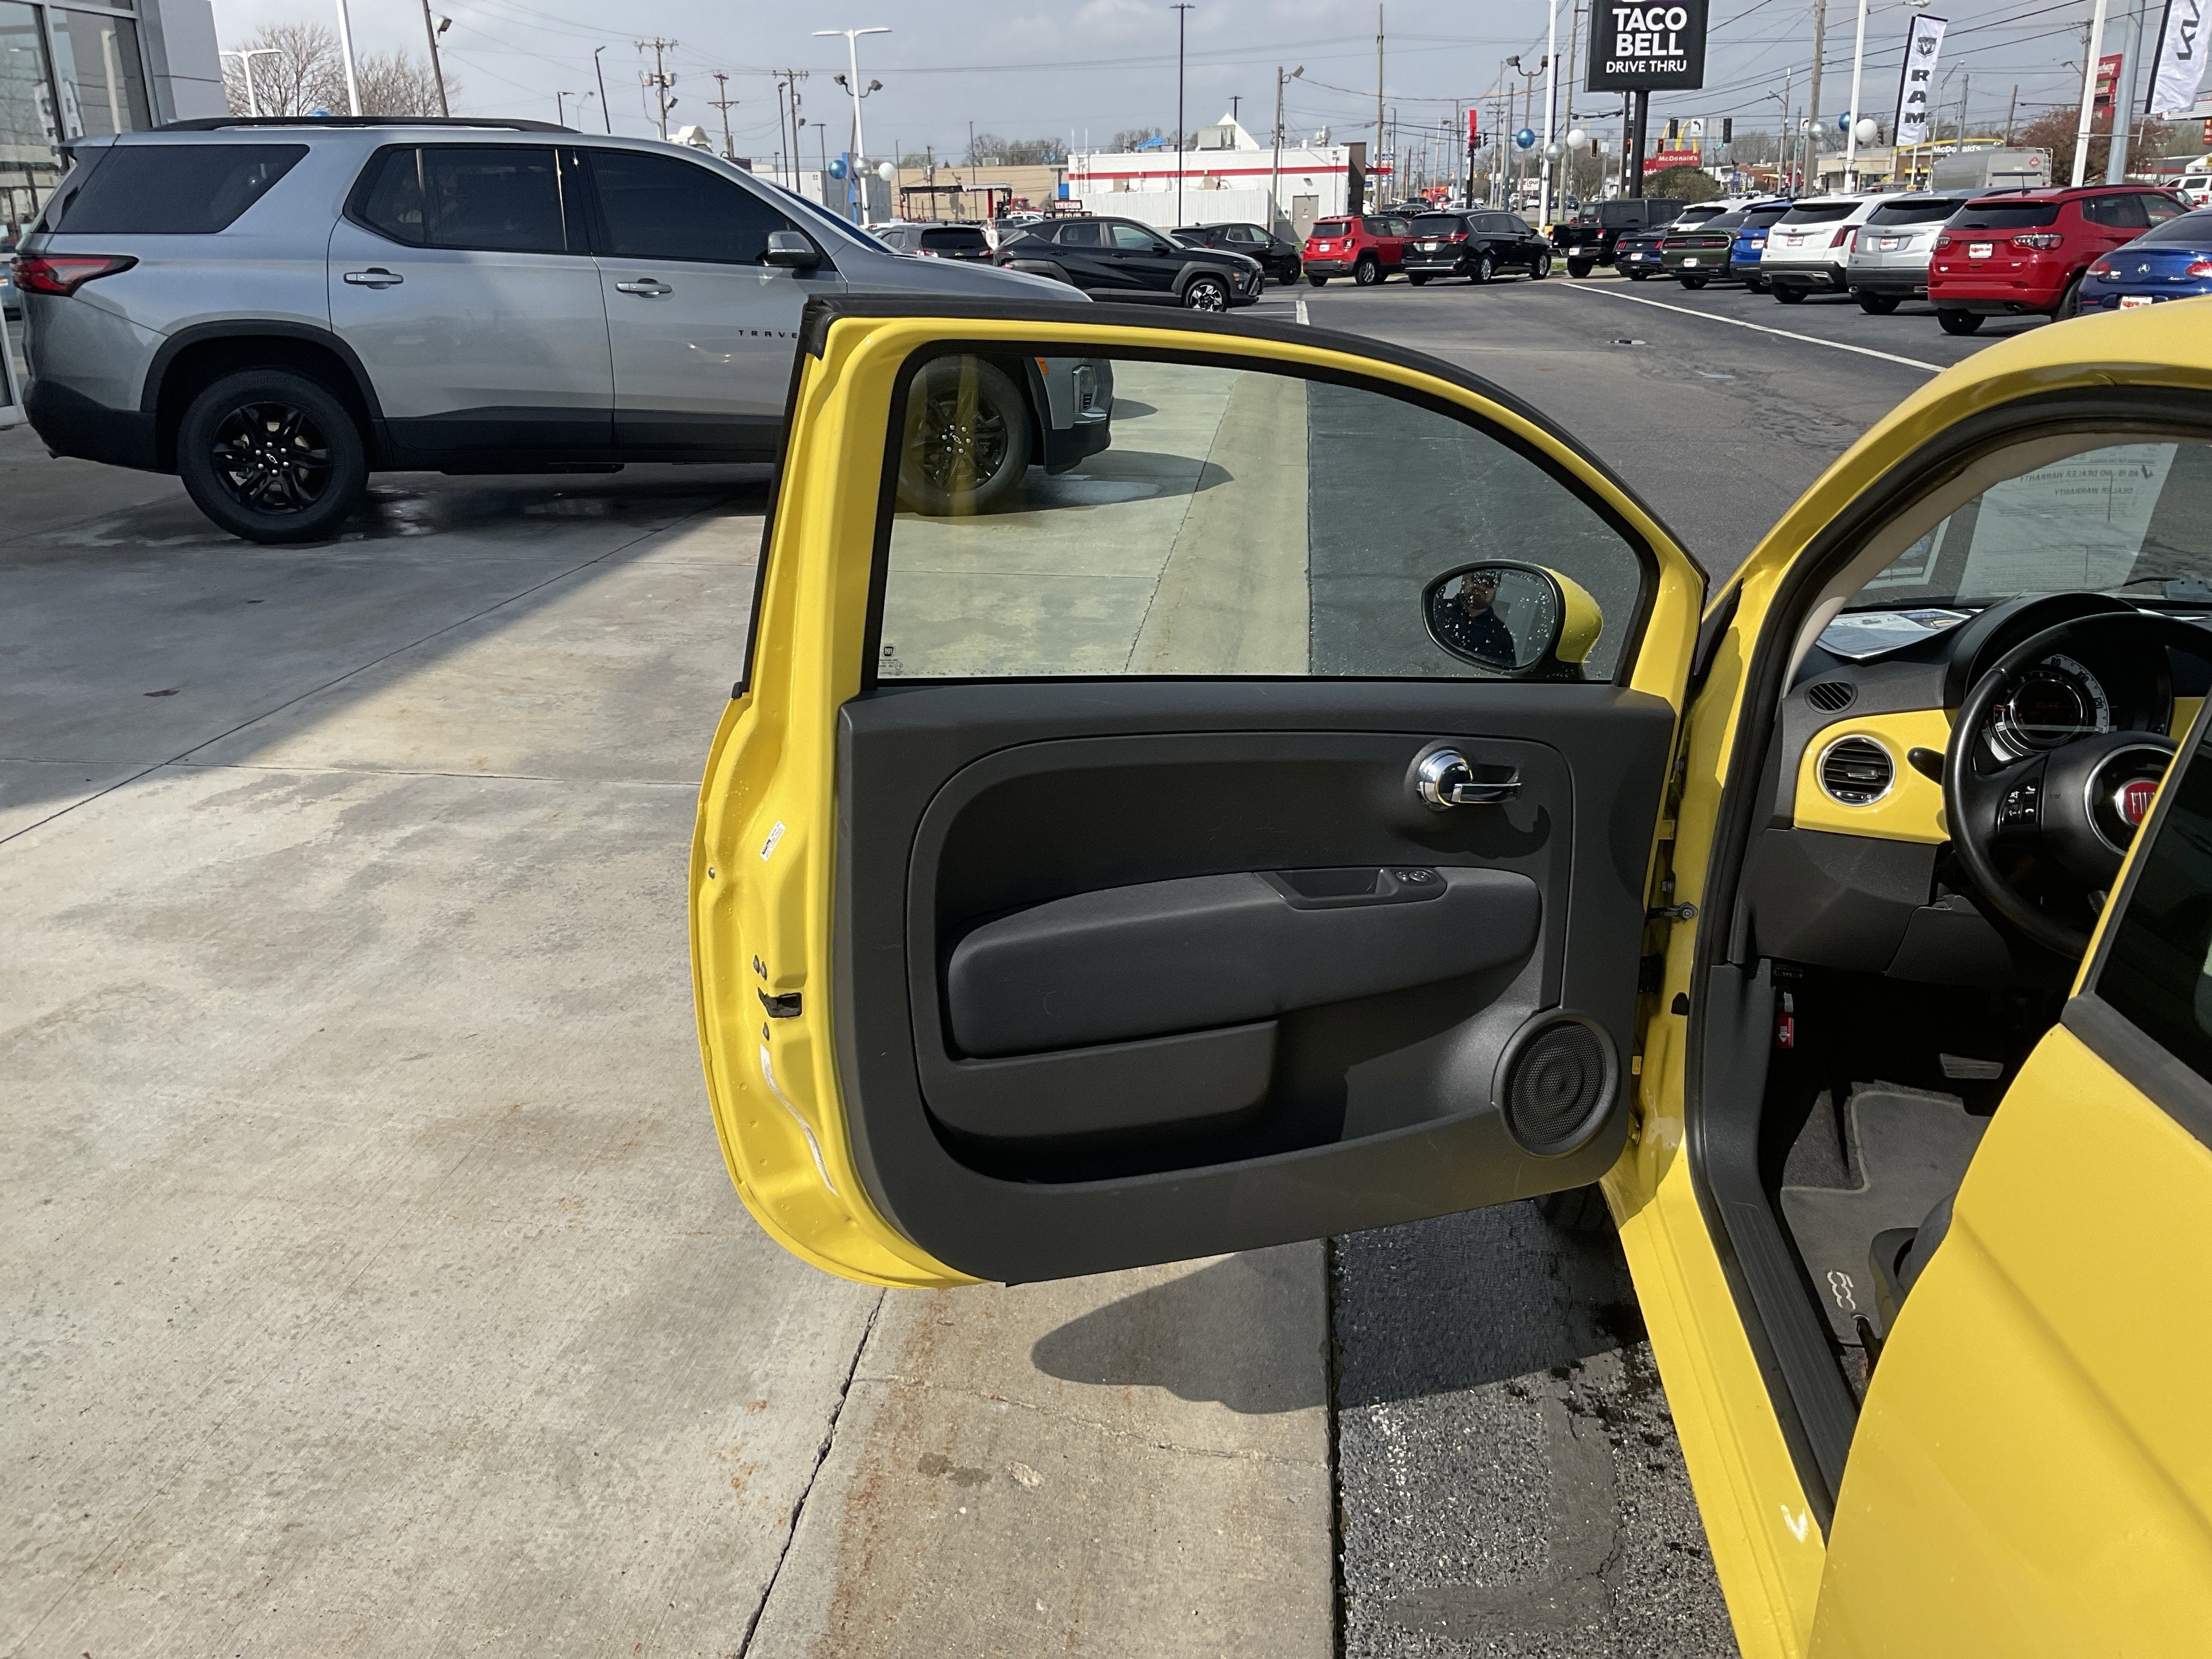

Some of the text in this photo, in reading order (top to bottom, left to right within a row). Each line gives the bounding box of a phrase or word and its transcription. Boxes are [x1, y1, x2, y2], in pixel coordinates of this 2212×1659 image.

[1612, 7, 1688, 31] TACO
[1616, 32, 1684, 57] BELL
[1606, 60, 1687, 74] DRIVE THRU
[1904, 69, 1930, 123] RAM
[1933, 145, 1981, 153] McDoald's
[738, 330, 798, 338] TRAVE
